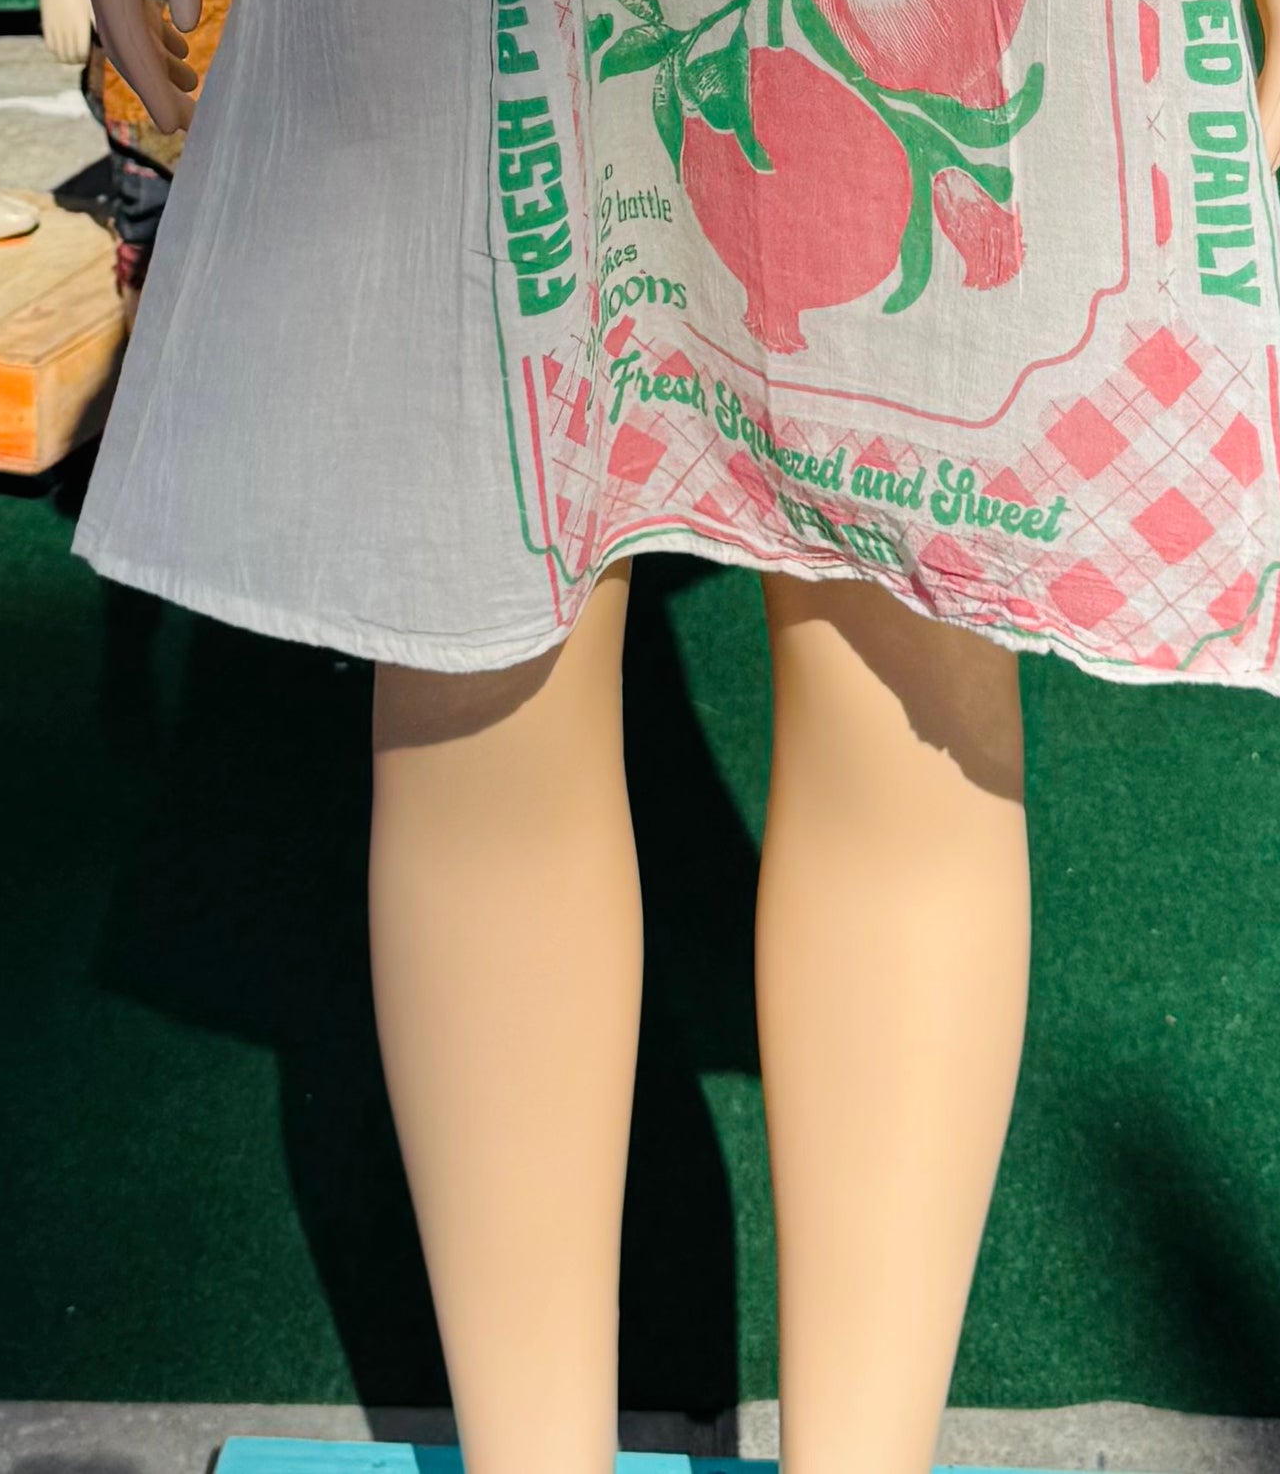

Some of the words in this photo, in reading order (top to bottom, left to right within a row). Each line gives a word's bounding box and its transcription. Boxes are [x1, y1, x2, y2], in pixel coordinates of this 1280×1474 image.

[497, 94, 577, 319] FRESH
[616, 185, 673, 224] bottle
[1187, 110, 1262, 309] DAILY
[609, 350, 708, 425] Fresh
[851, 463, 927, 511] and
[930, 458, 1073, 543] Sweet
